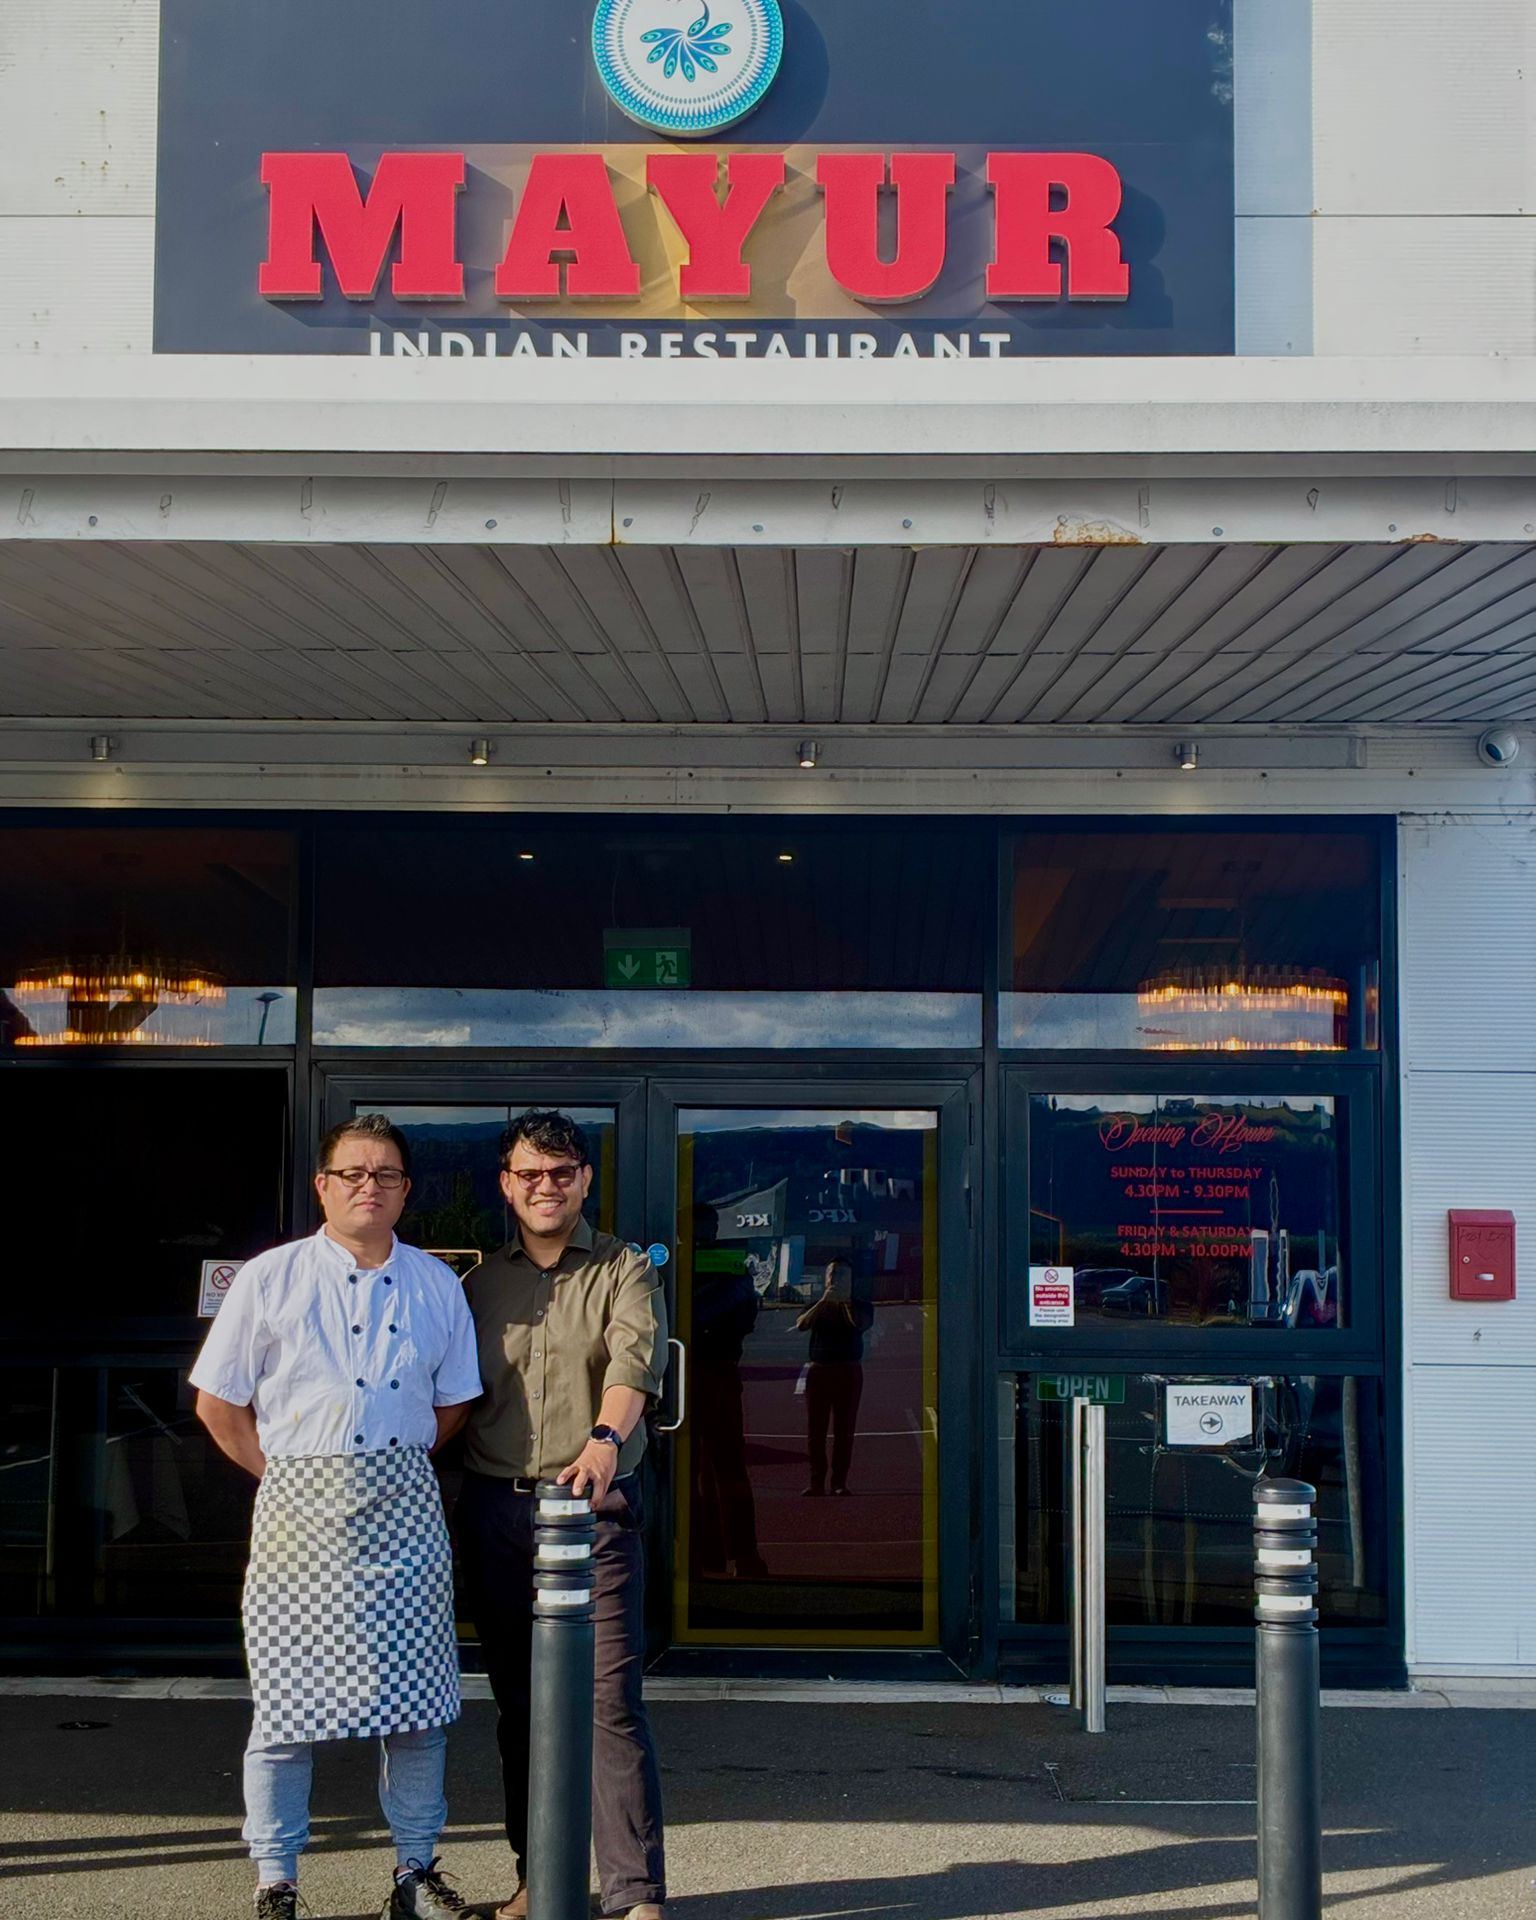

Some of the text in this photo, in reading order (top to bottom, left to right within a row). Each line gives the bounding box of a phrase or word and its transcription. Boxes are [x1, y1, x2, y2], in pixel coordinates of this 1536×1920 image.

[258, 152, 1129, 300] MAYUR
[370, 332, 1011, 357] INDIAN RESTAURANT
[1100, 1112, 1275, 1155] Opening Hours
[1110, 1167, 1263, 1179] SUNDAY to THURSDAY
[1124, 1185, 1180, 1197] 4.30PM
[1194, 1185, 1249, 1198] 9.30PM
[1117, 1225, 1256, 1237] FRIDAY & SATURDAY
[1120, 1243, 1176, 1256] 4.30PM
[1190, 1243, 1255, 1257] 10.00PM
[1056, 1375, 1109, 1399] OPEN
[1174, 1395, 1247, 1406] TAKEAWAY
